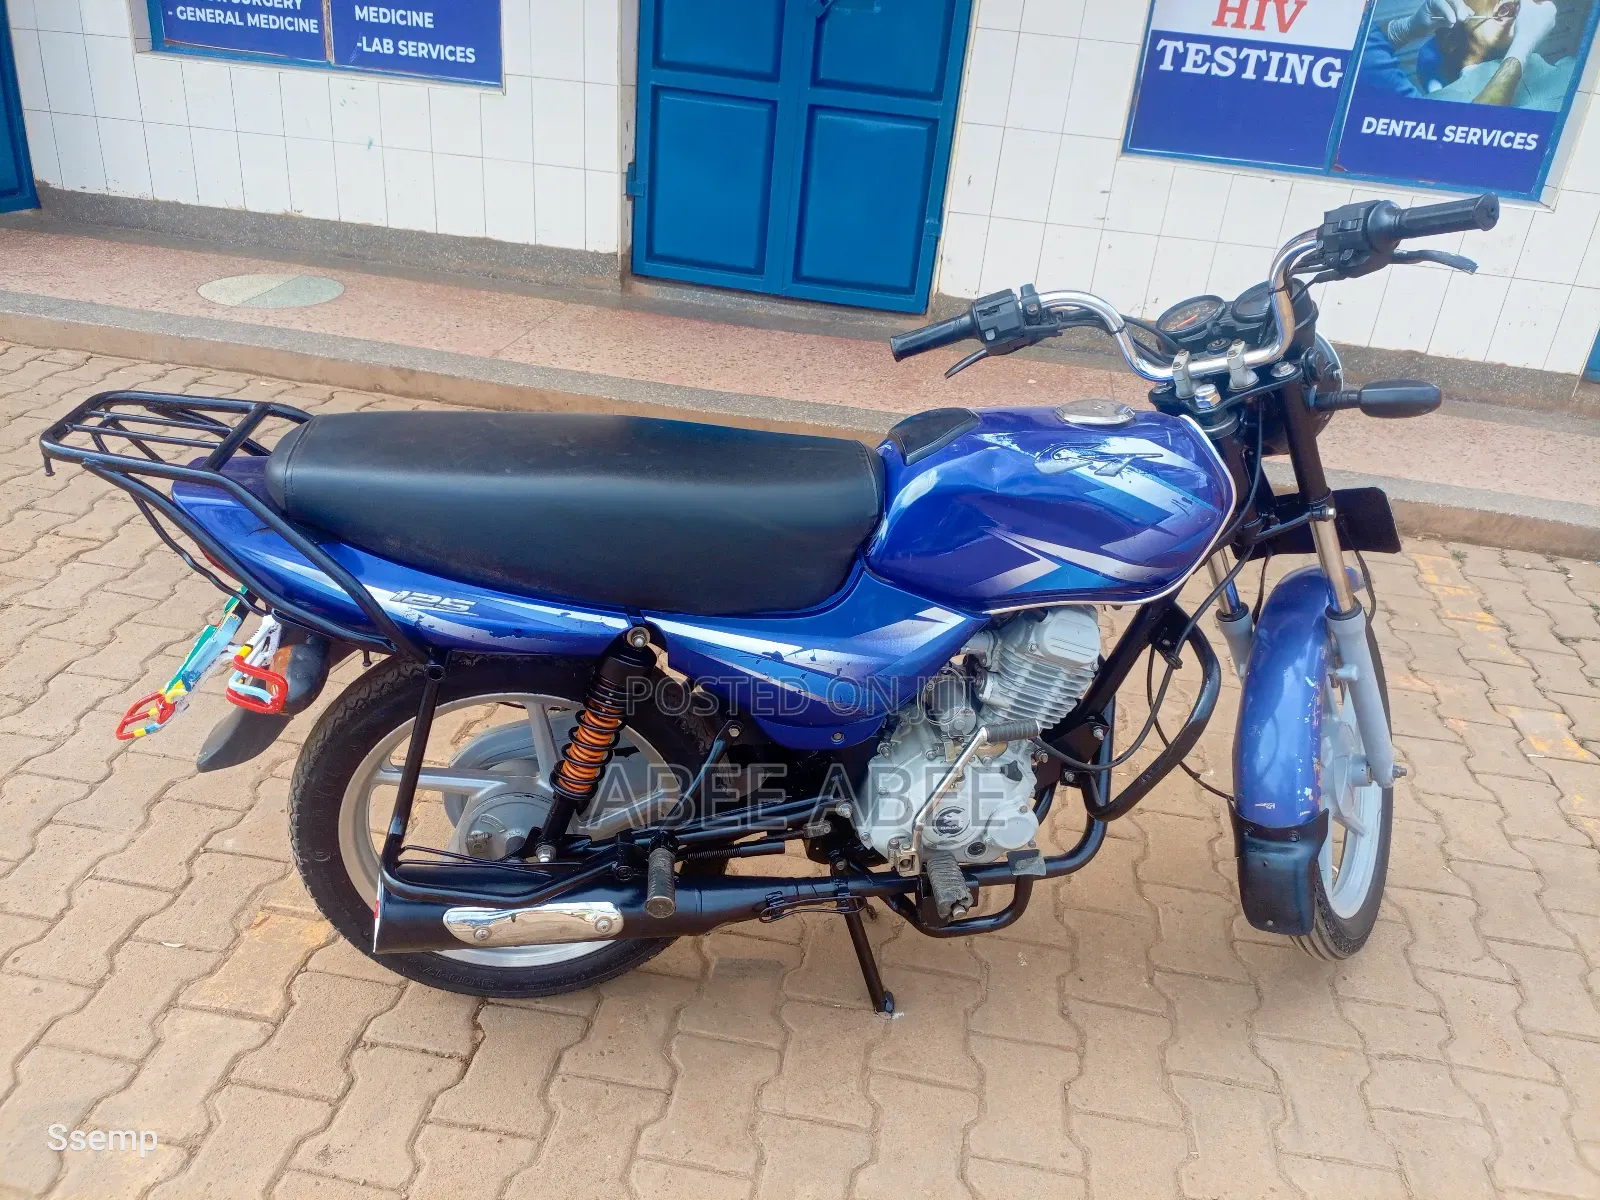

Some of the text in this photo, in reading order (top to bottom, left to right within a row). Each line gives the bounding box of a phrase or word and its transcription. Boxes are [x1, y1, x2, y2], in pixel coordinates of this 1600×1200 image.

[231, 0, 302, 10] GERY
[354, 5, 434, 28] MEDICINE
[1211, 0, 1307, 33] HIV
[176, 6, 244, 26] GENERAL
[247, 13, 319, 33] MEDICINE
[357, 36, 476, 63] -LAB SERVICES
[1156, 39, 1343, 88] TESTING
[1361, 116, 1539, 151] DENTAL SERVICES
[389, 590, 478, 612] 125
